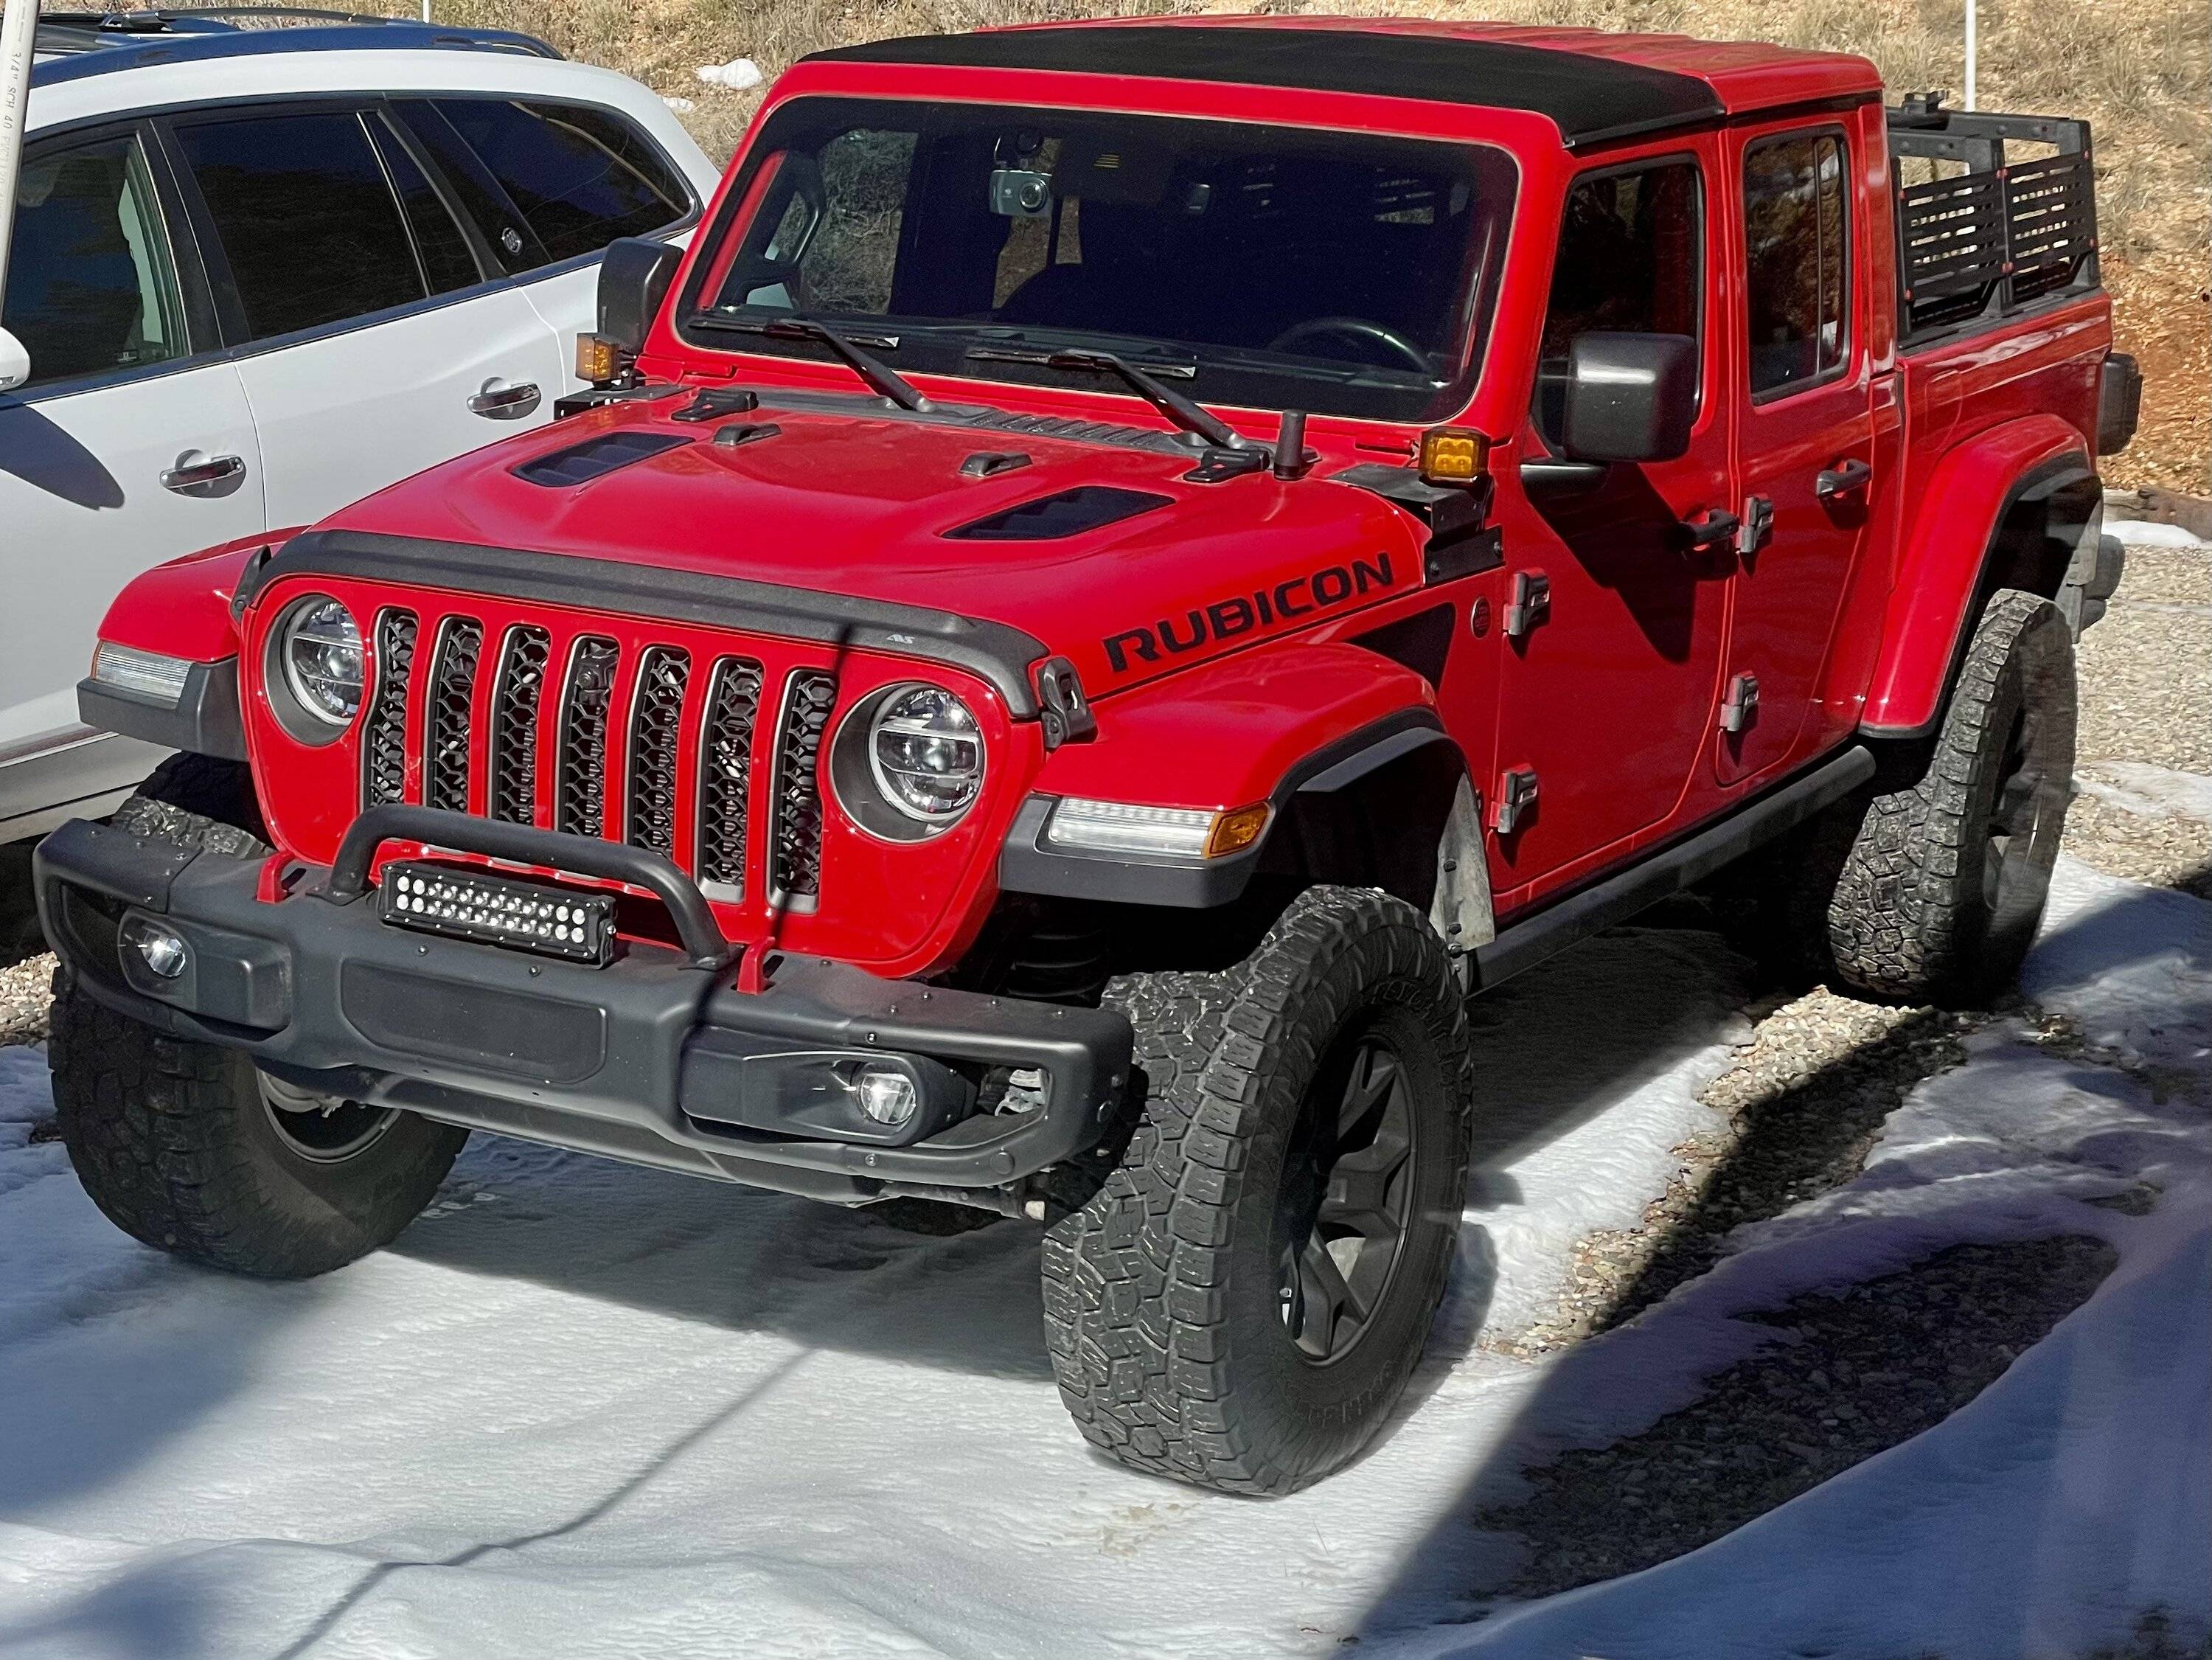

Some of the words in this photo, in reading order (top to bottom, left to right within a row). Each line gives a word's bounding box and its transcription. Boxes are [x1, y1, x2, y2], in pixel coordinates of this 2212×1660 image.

[6, 86, 17, 109] SCH
[3, 115, 14, 130] 40
[1102, 551, 1394, 673] RUBICON
